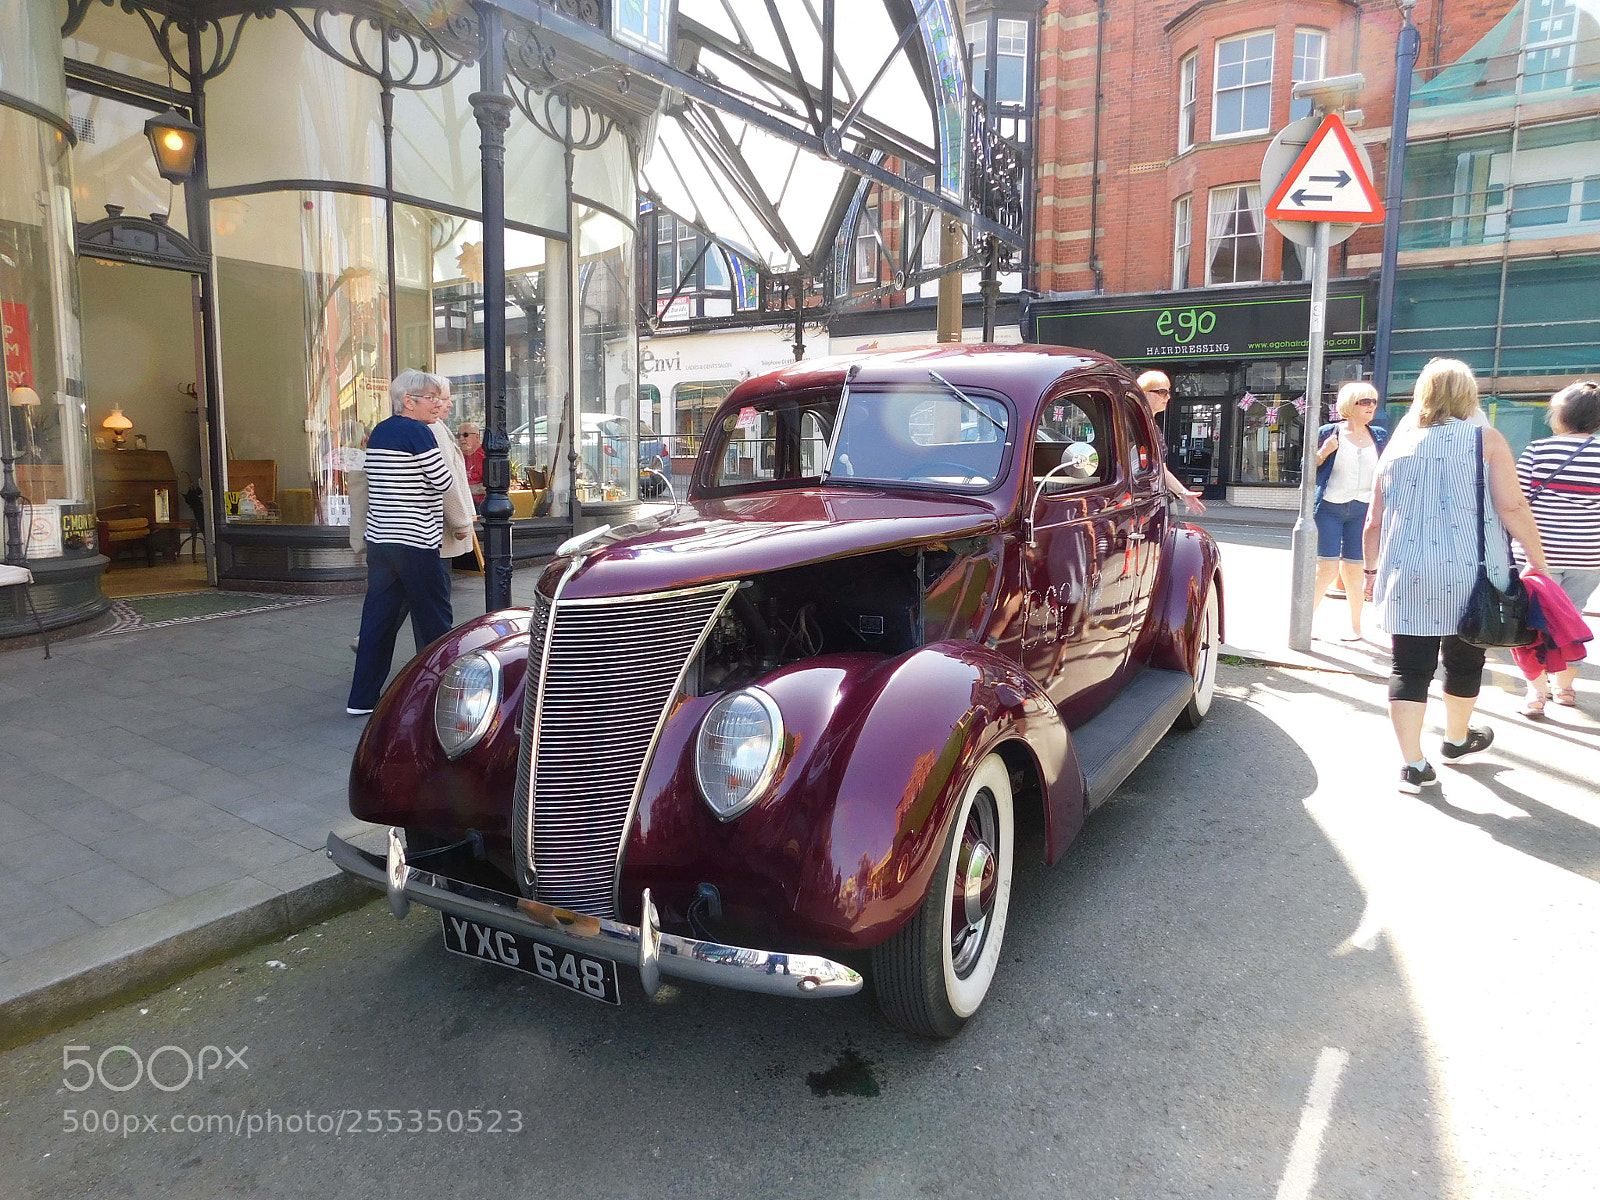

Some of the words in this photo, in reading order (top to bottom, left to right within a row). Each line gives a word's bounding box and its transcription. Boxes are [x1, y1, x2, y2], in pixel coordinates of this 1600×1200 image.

[1156, 309, 1217, 343] ego
[1146, 343, 1230, 356] HAIRDRESSING
[1247, 338, 1356, 349] www.egohairdrng.com
[450, 916, 520, 966] YXG
[533, 942, 606, 998] 648
